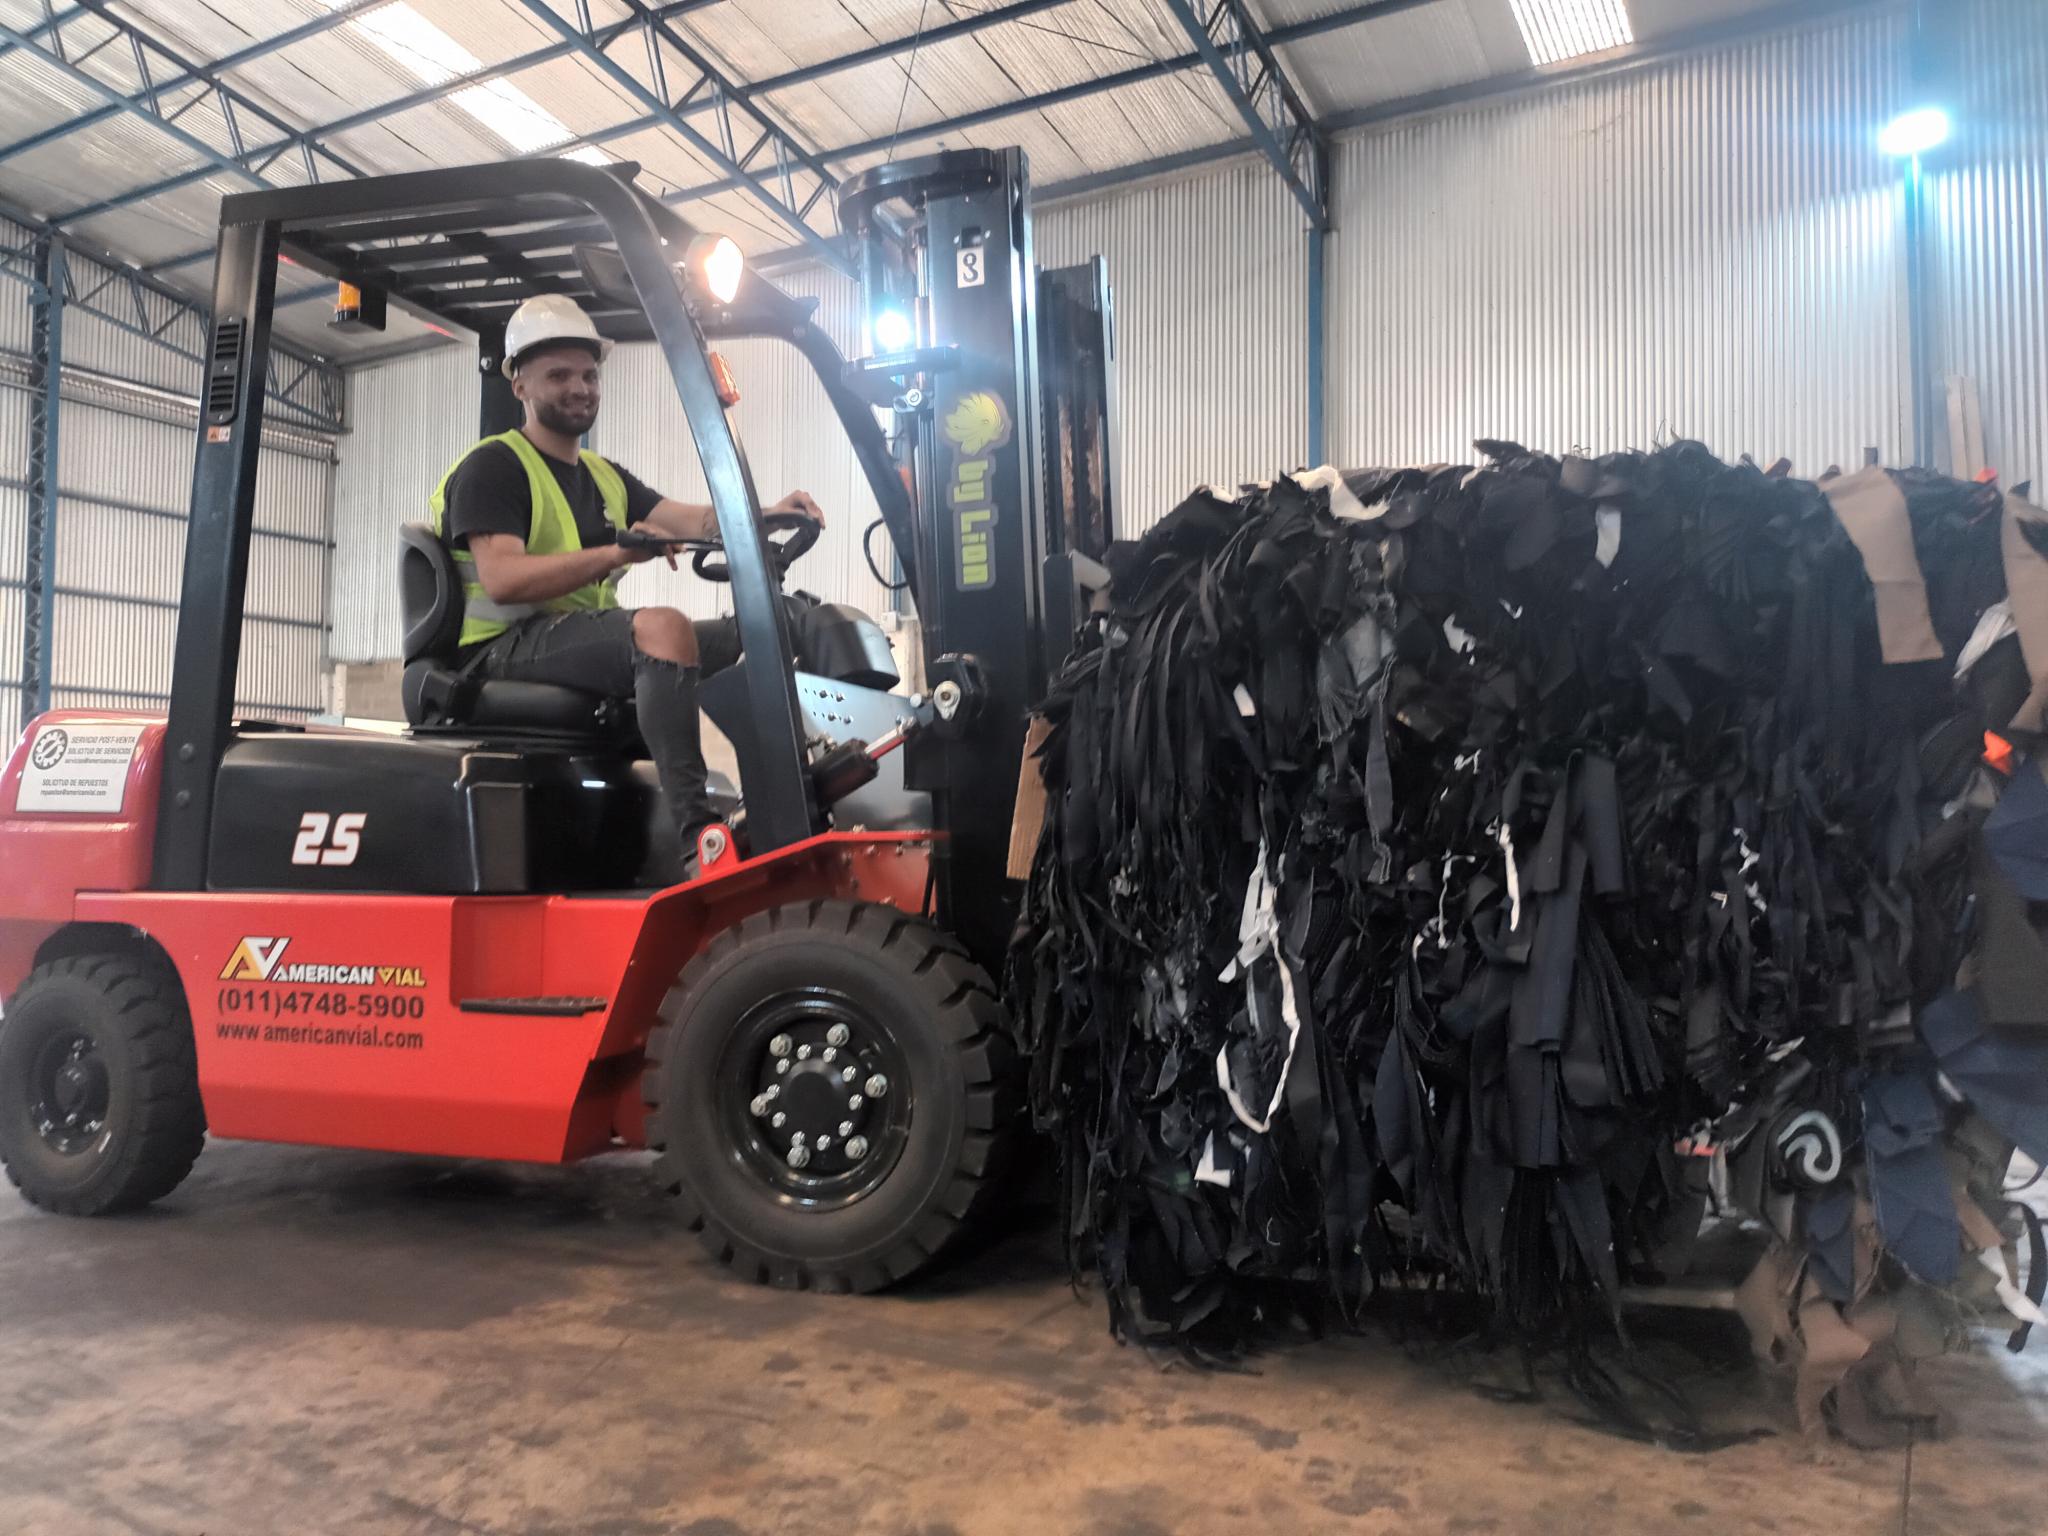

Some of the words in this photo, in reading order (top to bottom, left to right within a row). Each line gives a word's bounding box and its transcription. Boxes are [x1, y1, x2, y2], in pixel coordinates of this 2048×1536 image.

[961, 509, 990, 585] Lion
[42, 779, 69, 787] SOLICITUD
[70, 779, 77, 787] DE
[78, 779, 108, 787] REPUESTOS
[292, 812, 368, 866] 25
[377, 965, 426, 987] VIAL
[217, 988, 425, 1019] (011)4748-5900
[217, 1022, 424, 1048] wwwamericanvial.com
